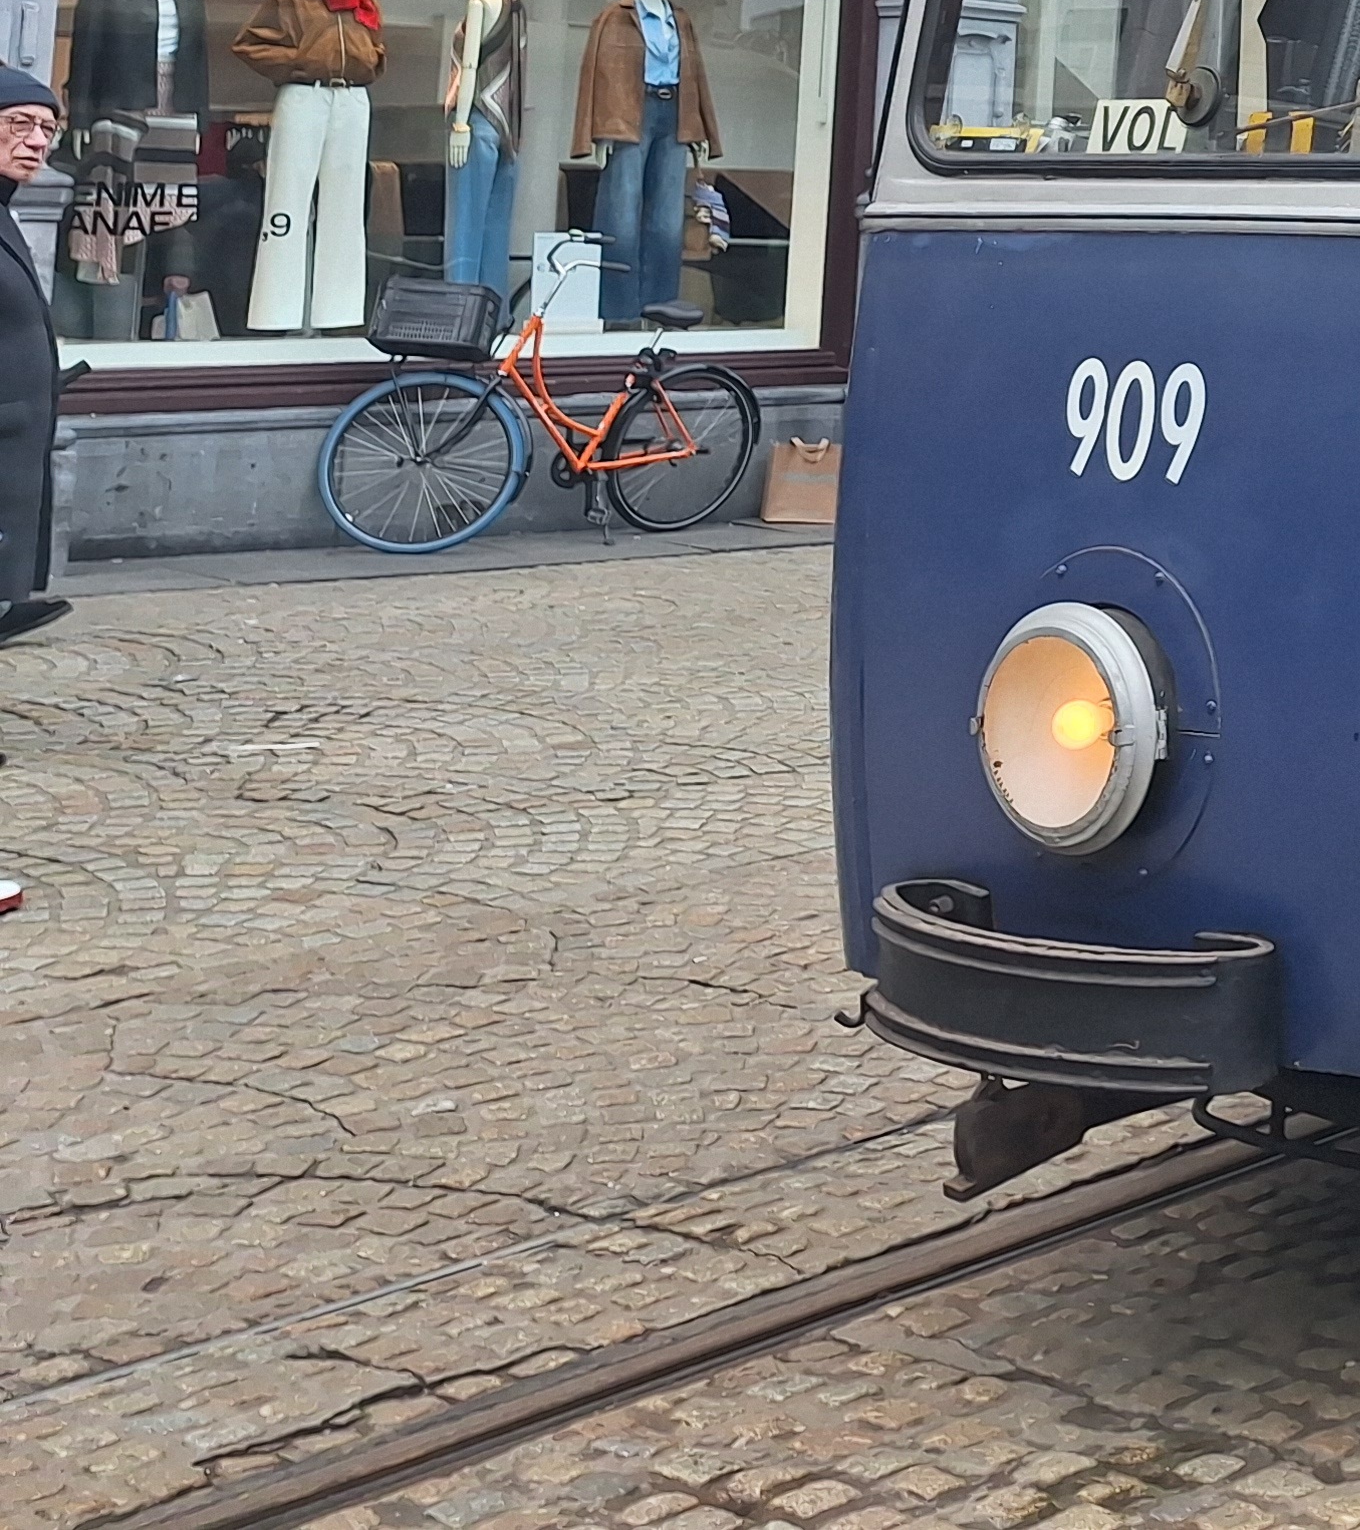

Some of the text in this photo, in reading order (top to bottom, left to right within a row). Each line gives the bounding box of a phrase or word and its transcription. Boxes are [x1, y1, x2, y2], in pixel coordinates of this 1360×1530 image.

[1102, 104, 1178, 152] VOL
[71, 181, 167, 208] ENIM
[1066, 357, 1206, 486] 909
